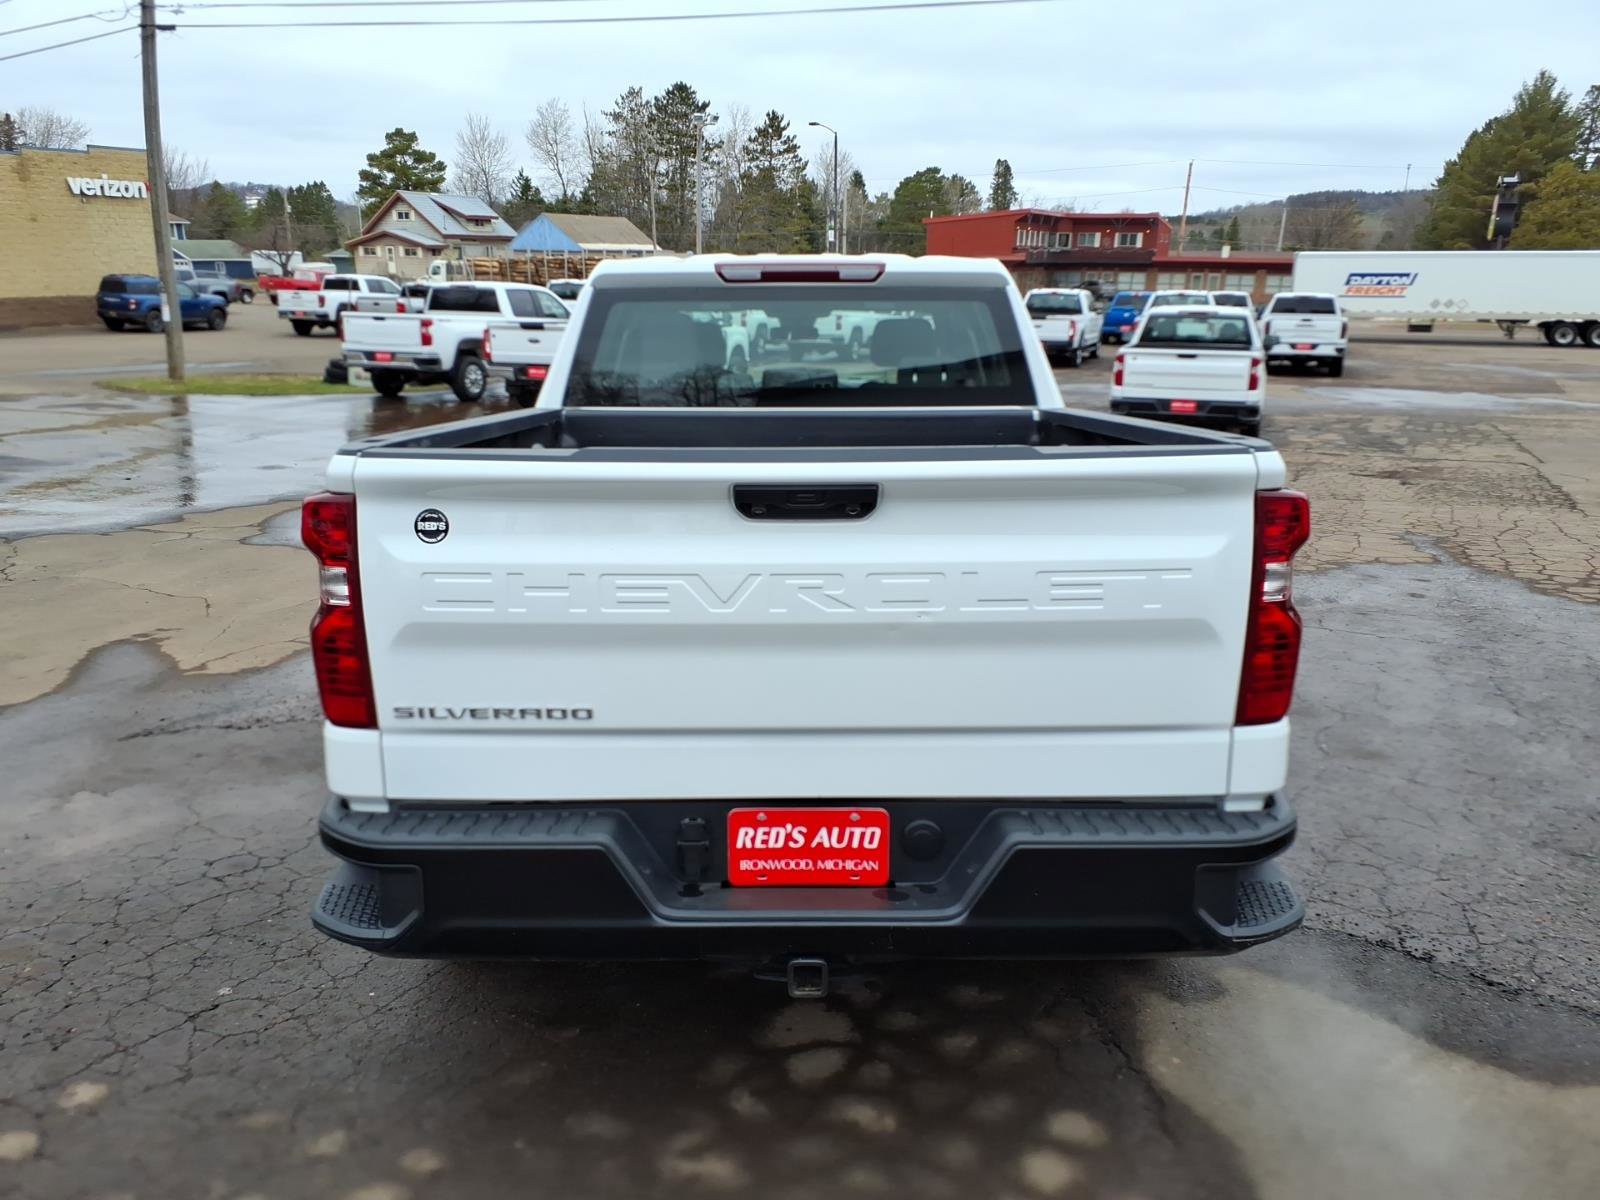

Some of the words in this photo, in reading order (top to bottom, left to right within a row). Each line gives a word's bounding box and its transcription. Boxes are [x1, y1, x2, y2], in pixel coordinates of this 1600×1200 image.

[66, 173, 148, 198] verizon
[1348, 275, 1412, 285] DAYTON
[1345, 286, 1409, 295] FREIGHT
[416, 521, 447, 531] RED'S
[421, 569, 1193, 613] CHEVROLET
[393, 706, 594, 721] SILVERADO
[735, 822, 807, 850] RED'S
[810, 826, 883, 850] AUTO
[739, 859, 815, 872] IRONWOOD,
[816, 859, 879, 872] MICHIGAN
